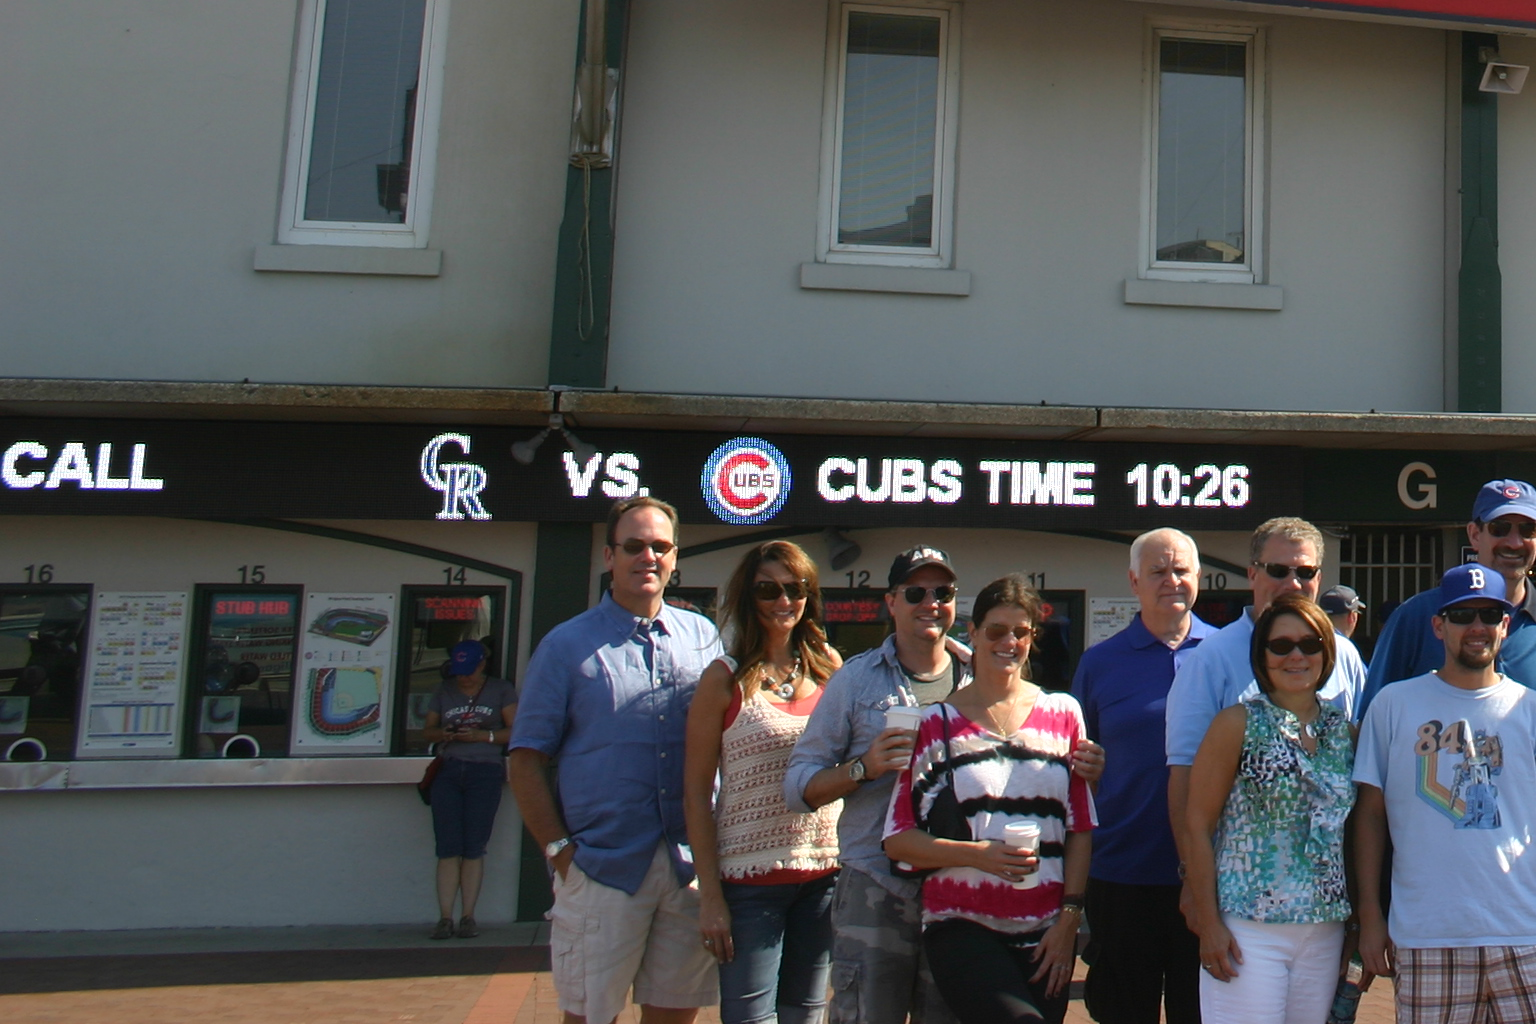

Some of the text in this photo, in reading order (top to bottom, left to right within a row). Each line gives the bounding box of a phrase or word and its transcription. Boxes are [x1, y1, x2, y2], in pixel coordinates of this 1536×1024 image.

[1, 441, 164, 492] CALL
[563, 452, 649, 497] VS.
[817, 457, 1249, 509] CUBS TIME 10:26
[1397, 461, 1437, 510] G
[1503, 486, 1520, 499] C
[24, 564, 55, 584] 16
[237, 565, 266, 584] 15
[443, 566, 466, 586] 14
[846, 570, 870, 589] 12
[1205, 573, 1227, 590] 10
[1468, 568, 1485, 589] B
[215, 601, 290, 615] STUB HUB
[1414, 720, 1466, 756] 84
